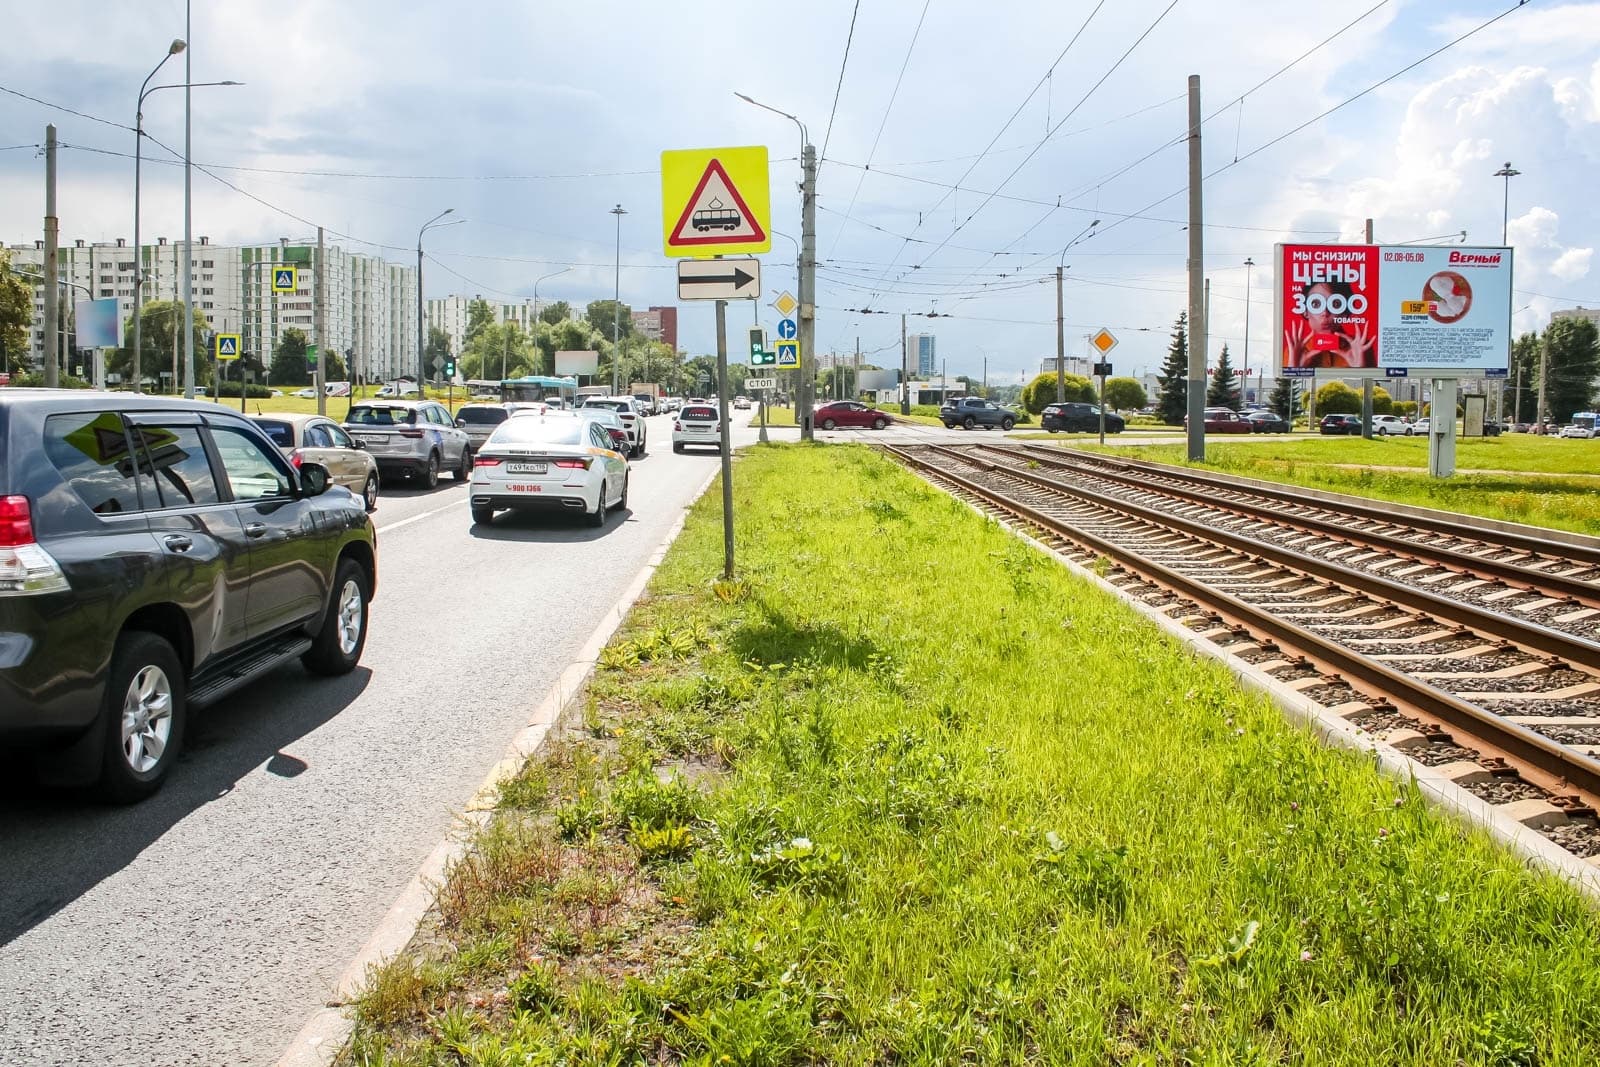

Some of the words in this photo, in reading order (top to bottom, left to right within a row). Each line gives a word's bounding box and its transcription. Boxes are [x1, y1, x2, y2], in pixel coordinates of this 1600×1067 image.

[1292, 251, 1312, 261] МЫ
[1314, 251, 1366, 262] СНИЗИЛИ
[1384, 252, 1425, 263] 02.08-05.08
[1292, 262, 1367, 291] ЦЕНЫ
[1291, 293, 1368, 315] 3000
[749, 379, 772, 388] СТОП
[512, 484, 525, 492] 900
